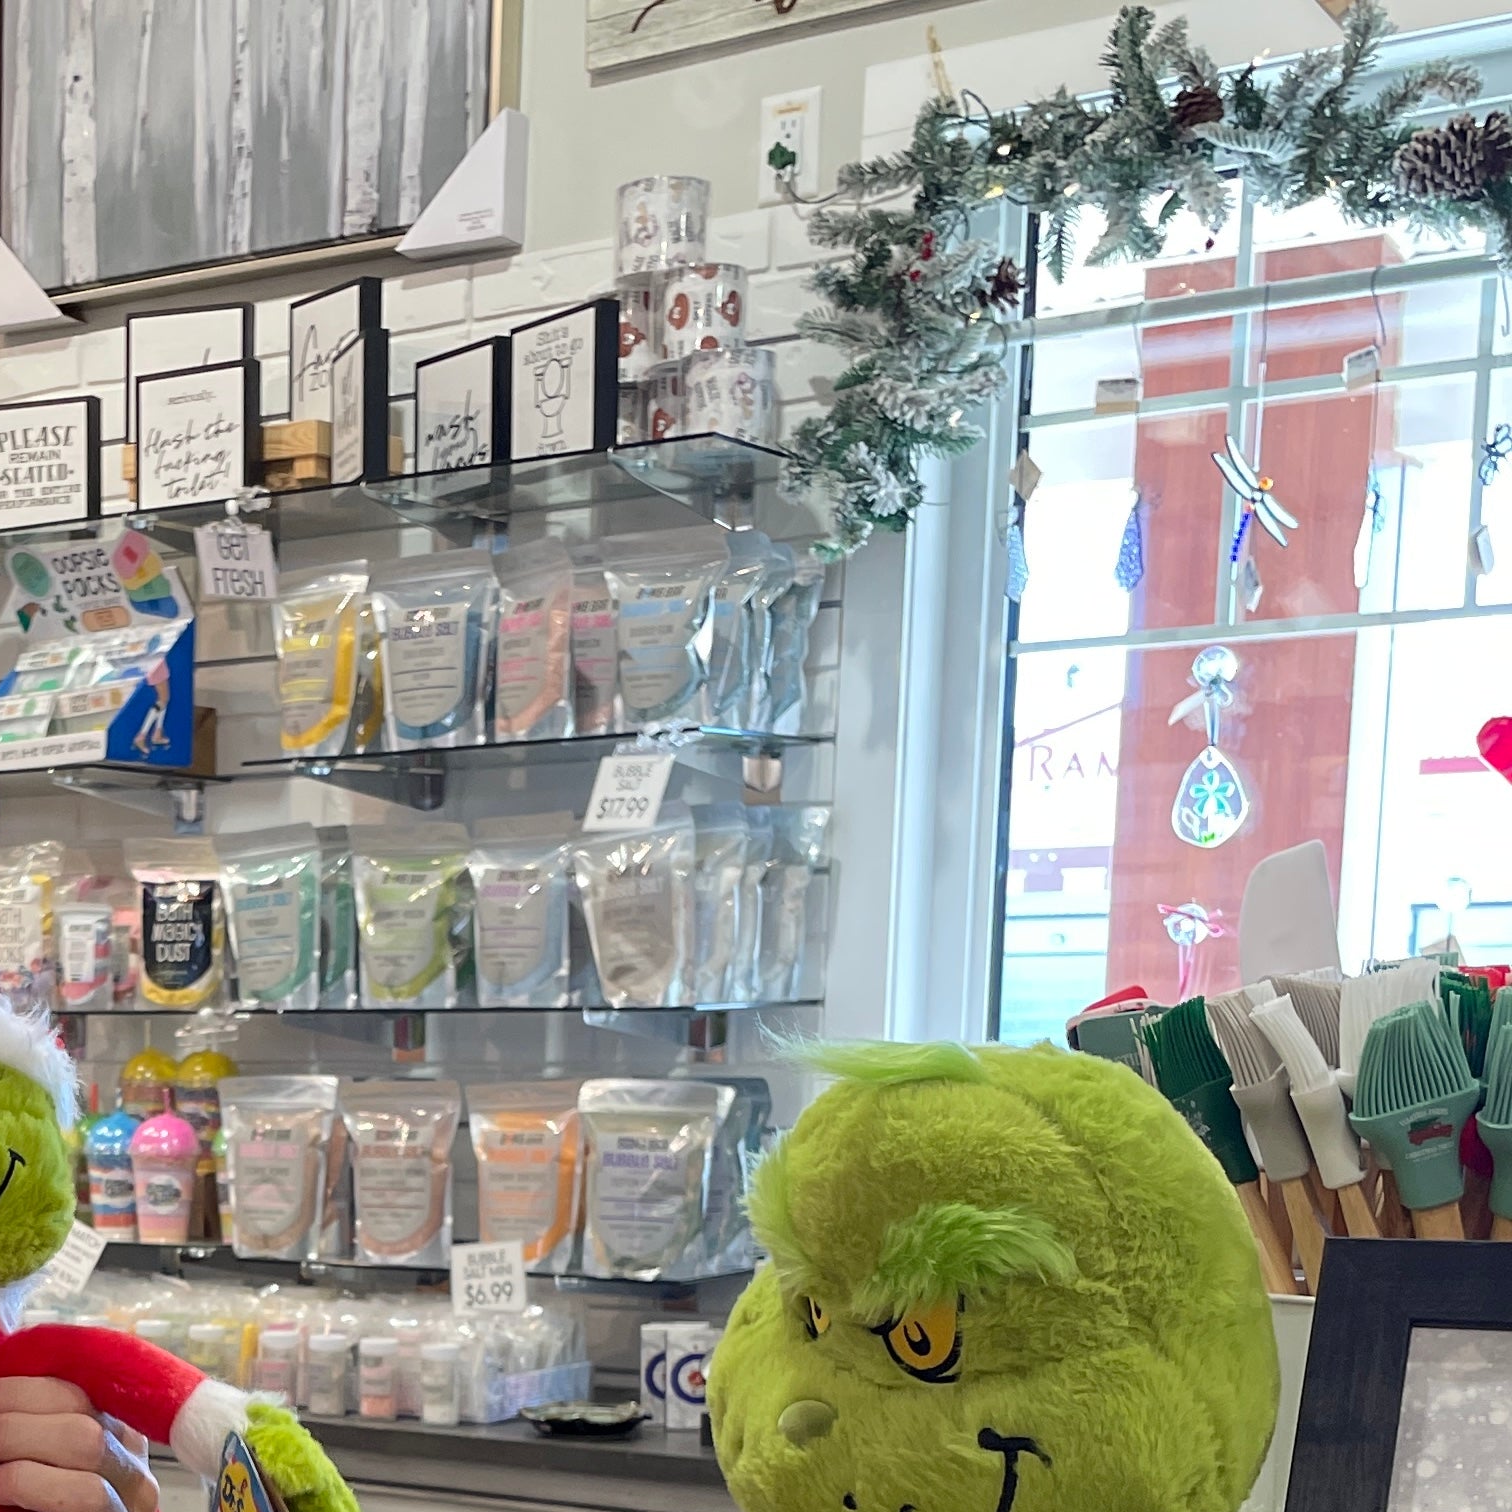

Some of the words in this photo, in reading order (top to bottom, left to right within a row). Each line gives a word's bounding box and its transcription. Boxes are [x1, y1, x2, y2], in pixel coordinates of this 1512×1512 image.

[204, 411, 240, 441] the
[8, 449, 62, 464] REMAIN
[155, 943, 192, 962] DUST
[464, 1280, 513, 1307] $6.99
